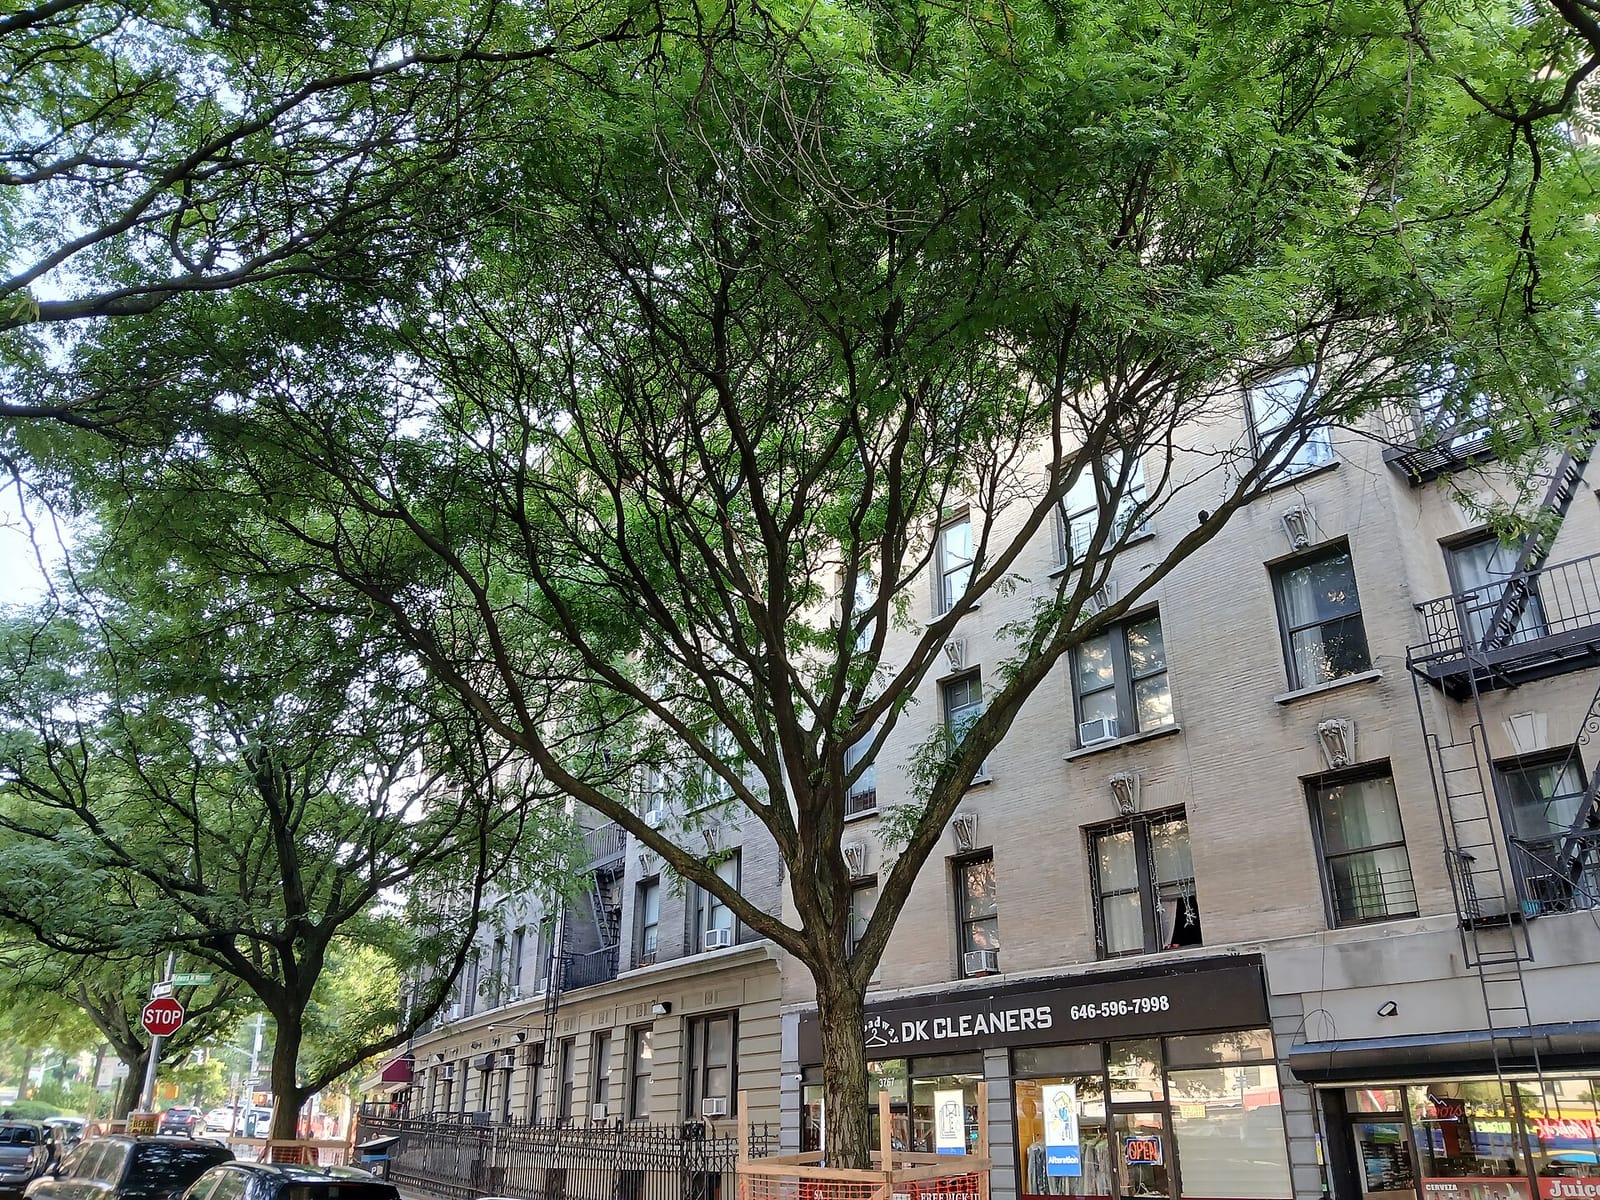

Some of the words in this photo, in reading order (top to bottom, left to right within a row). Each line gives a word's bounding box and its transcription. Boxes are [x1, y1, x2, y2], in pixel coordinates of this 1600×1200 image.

[1069, 995, 1170, 1021] 646-596-7998
[144, 1009, 182, 1025] STOP
[901, 1019, 930, 1043] DK
[933, 1005, 1053, 1040] CLEANERS
[878, 1077, 895, 1087] 3767
[1129, 1140, 1159, 1161] OPEN
[1048, 1156, 1079, 1165] Alteration
[1425, 1183, 1459, 1191] CERVEZA
